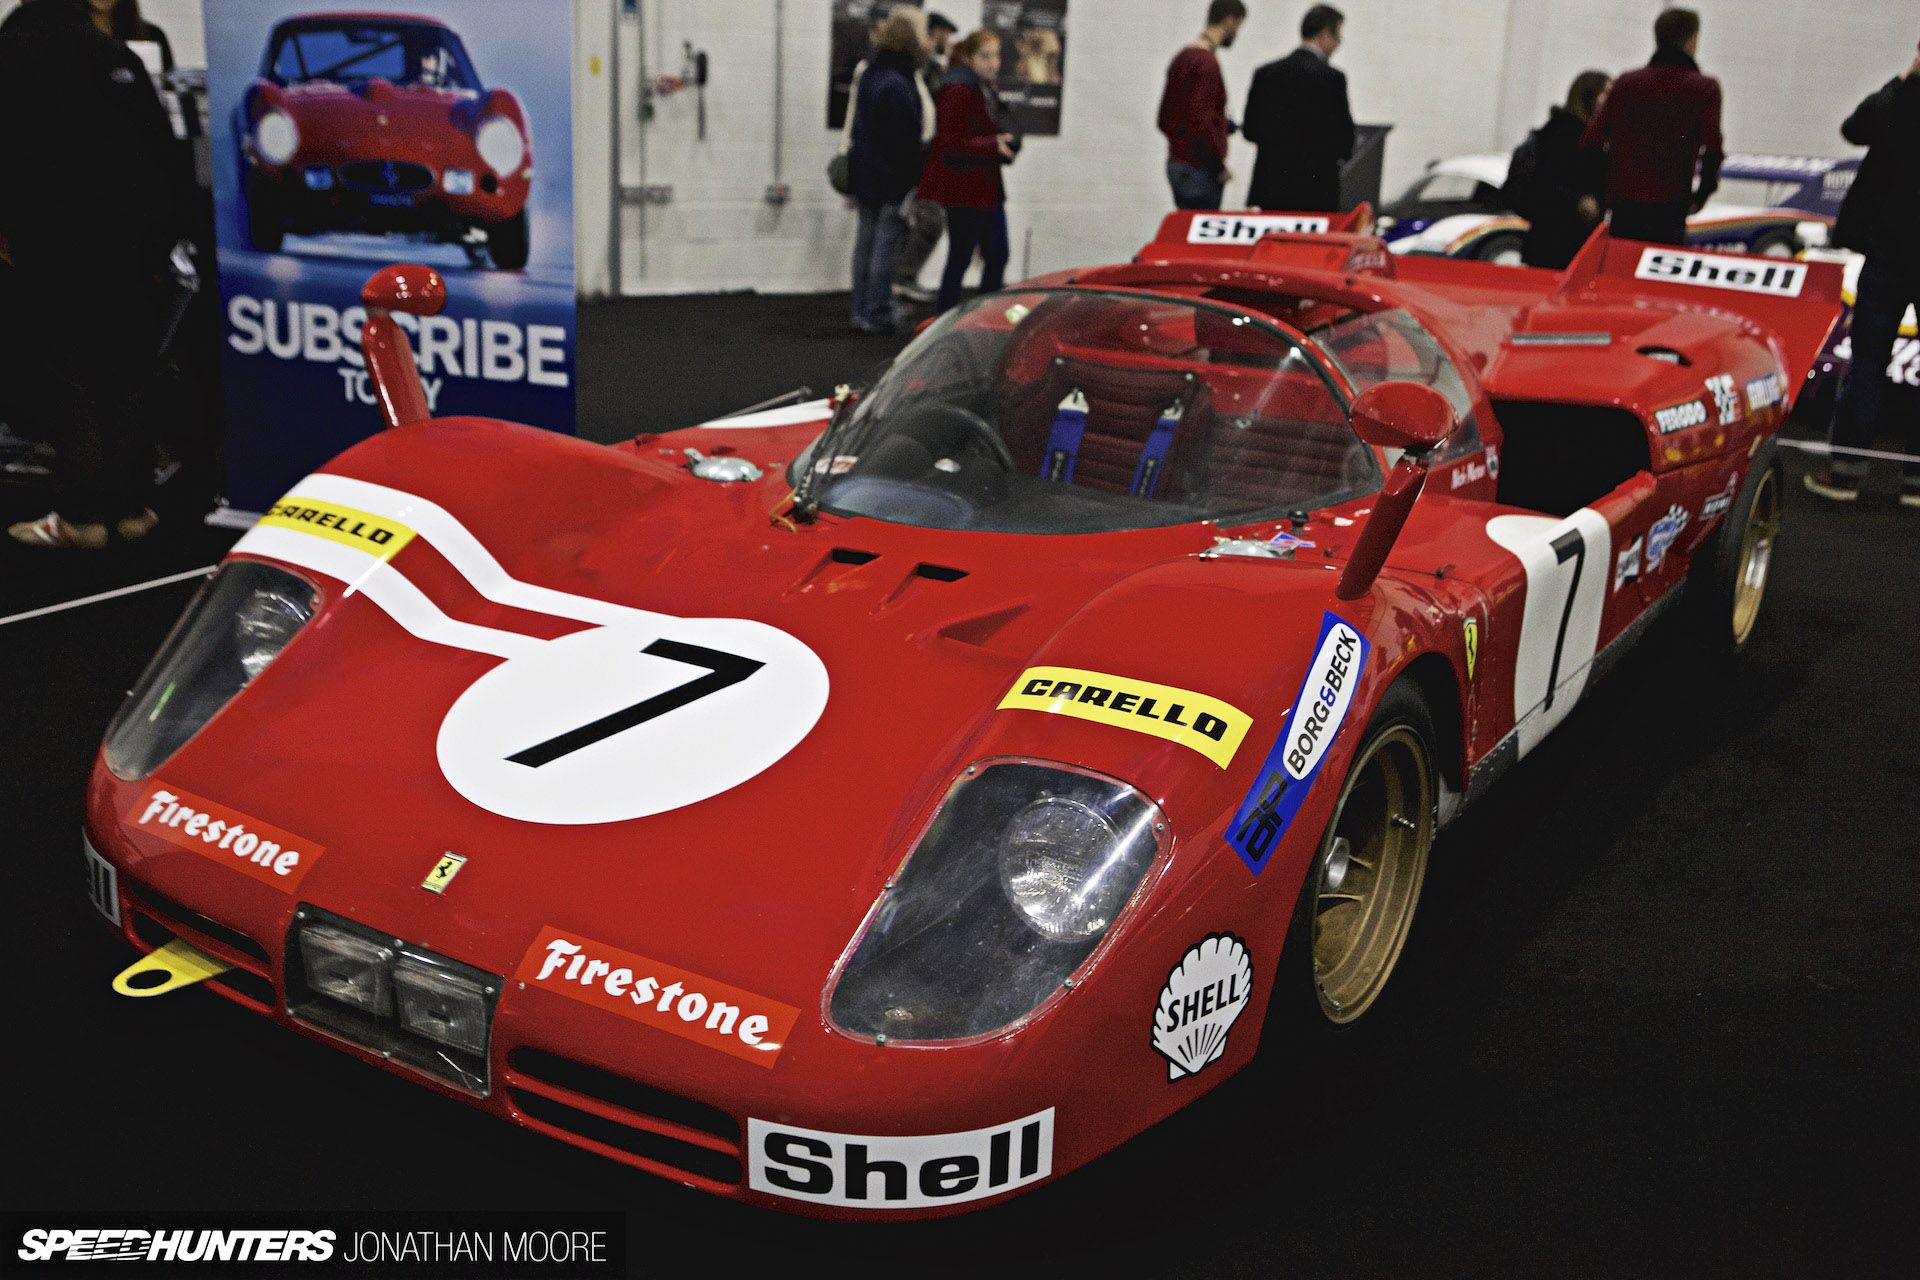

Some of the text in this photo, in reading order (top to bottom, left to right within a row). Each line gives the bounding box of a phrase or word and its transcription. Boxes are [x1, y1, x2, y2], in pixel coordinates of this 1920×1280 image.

[1647, 252, 1796, 291] Shell
[1549, 528, 1586, 713] 7
[503, 638, 766, 768] 7
[1020, 678, 1228, 742] CARELLO
[1286, 628, 1358, 775] BORG&BECK
[138, 790, 300, 877] Firestone
[536, 939, 773, 1047] Firestone
[1166, 973, 1241, 1033] SHELL
[763, 1121, 1041, 1202] Shell
